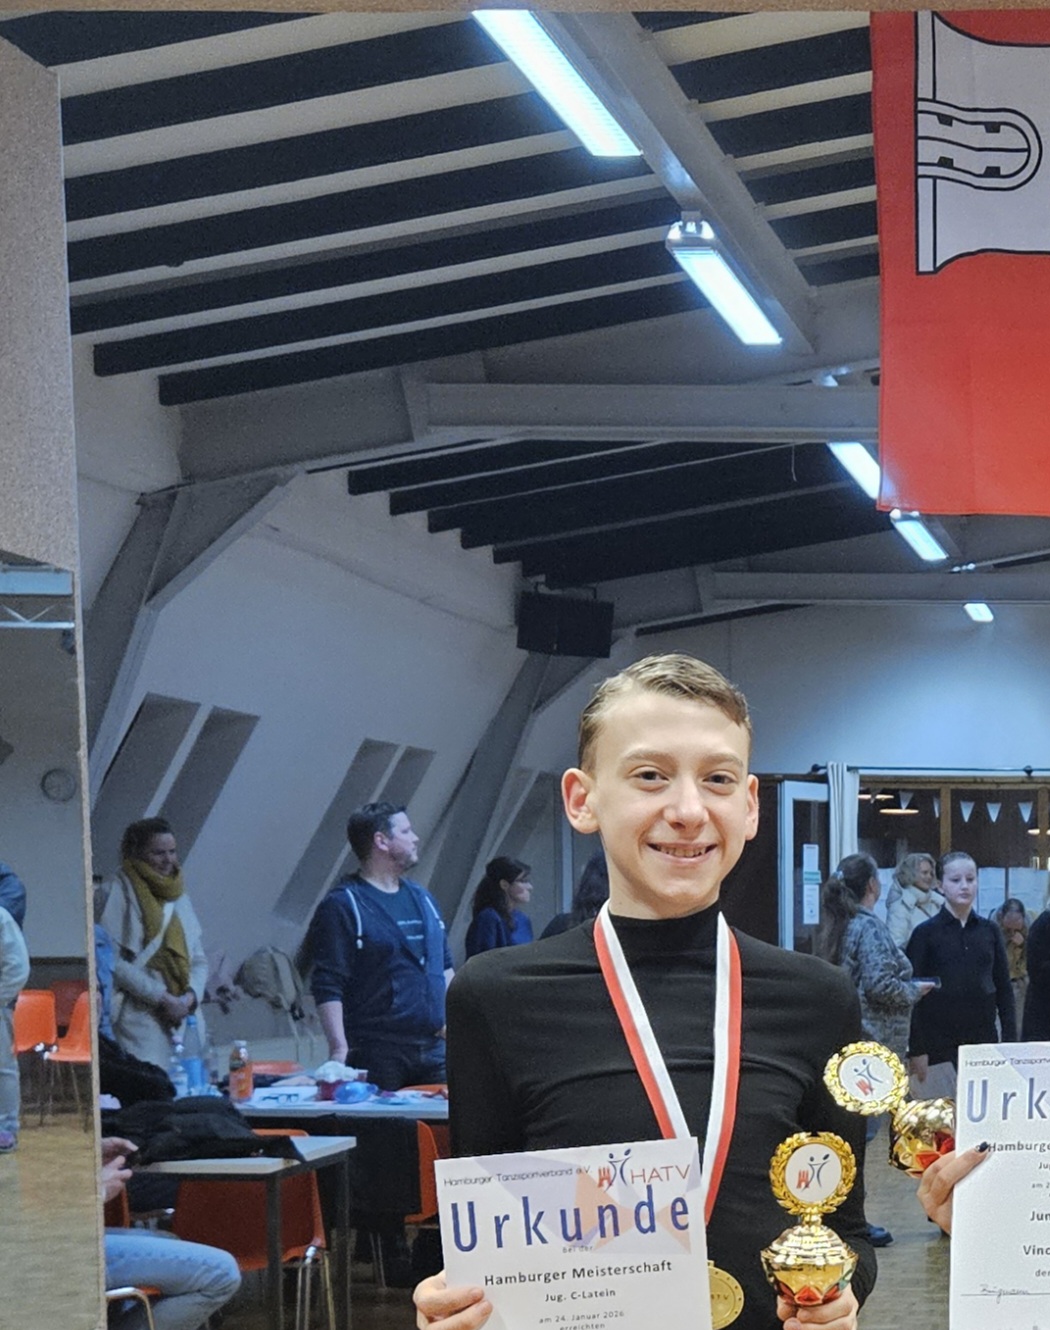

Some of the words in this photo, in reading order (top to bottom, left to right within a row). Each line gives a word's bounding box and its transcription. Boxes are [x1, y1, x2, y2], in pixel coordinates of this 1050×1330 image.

[965, 1059, 1006, 1067] Hamburger
[444, 1174, 493, 1187] Hamburger
[496, 1167, 573, 1181] Tanzsportverband
[630, 1164, 691, 1185] HATV
[451, 1184, 690, 1253] Urkunde
[484, 1268, 567, 1286] Hamburger
[572, 1261, 673, 1280] Meisterschaft
[545, 1292, 567, 1303] Jug.
[570, 1288, 616, 1300] C-Latein
[571, 1313, 601, 1322] Januar
[603, 1310, 625, 1319] 2026
